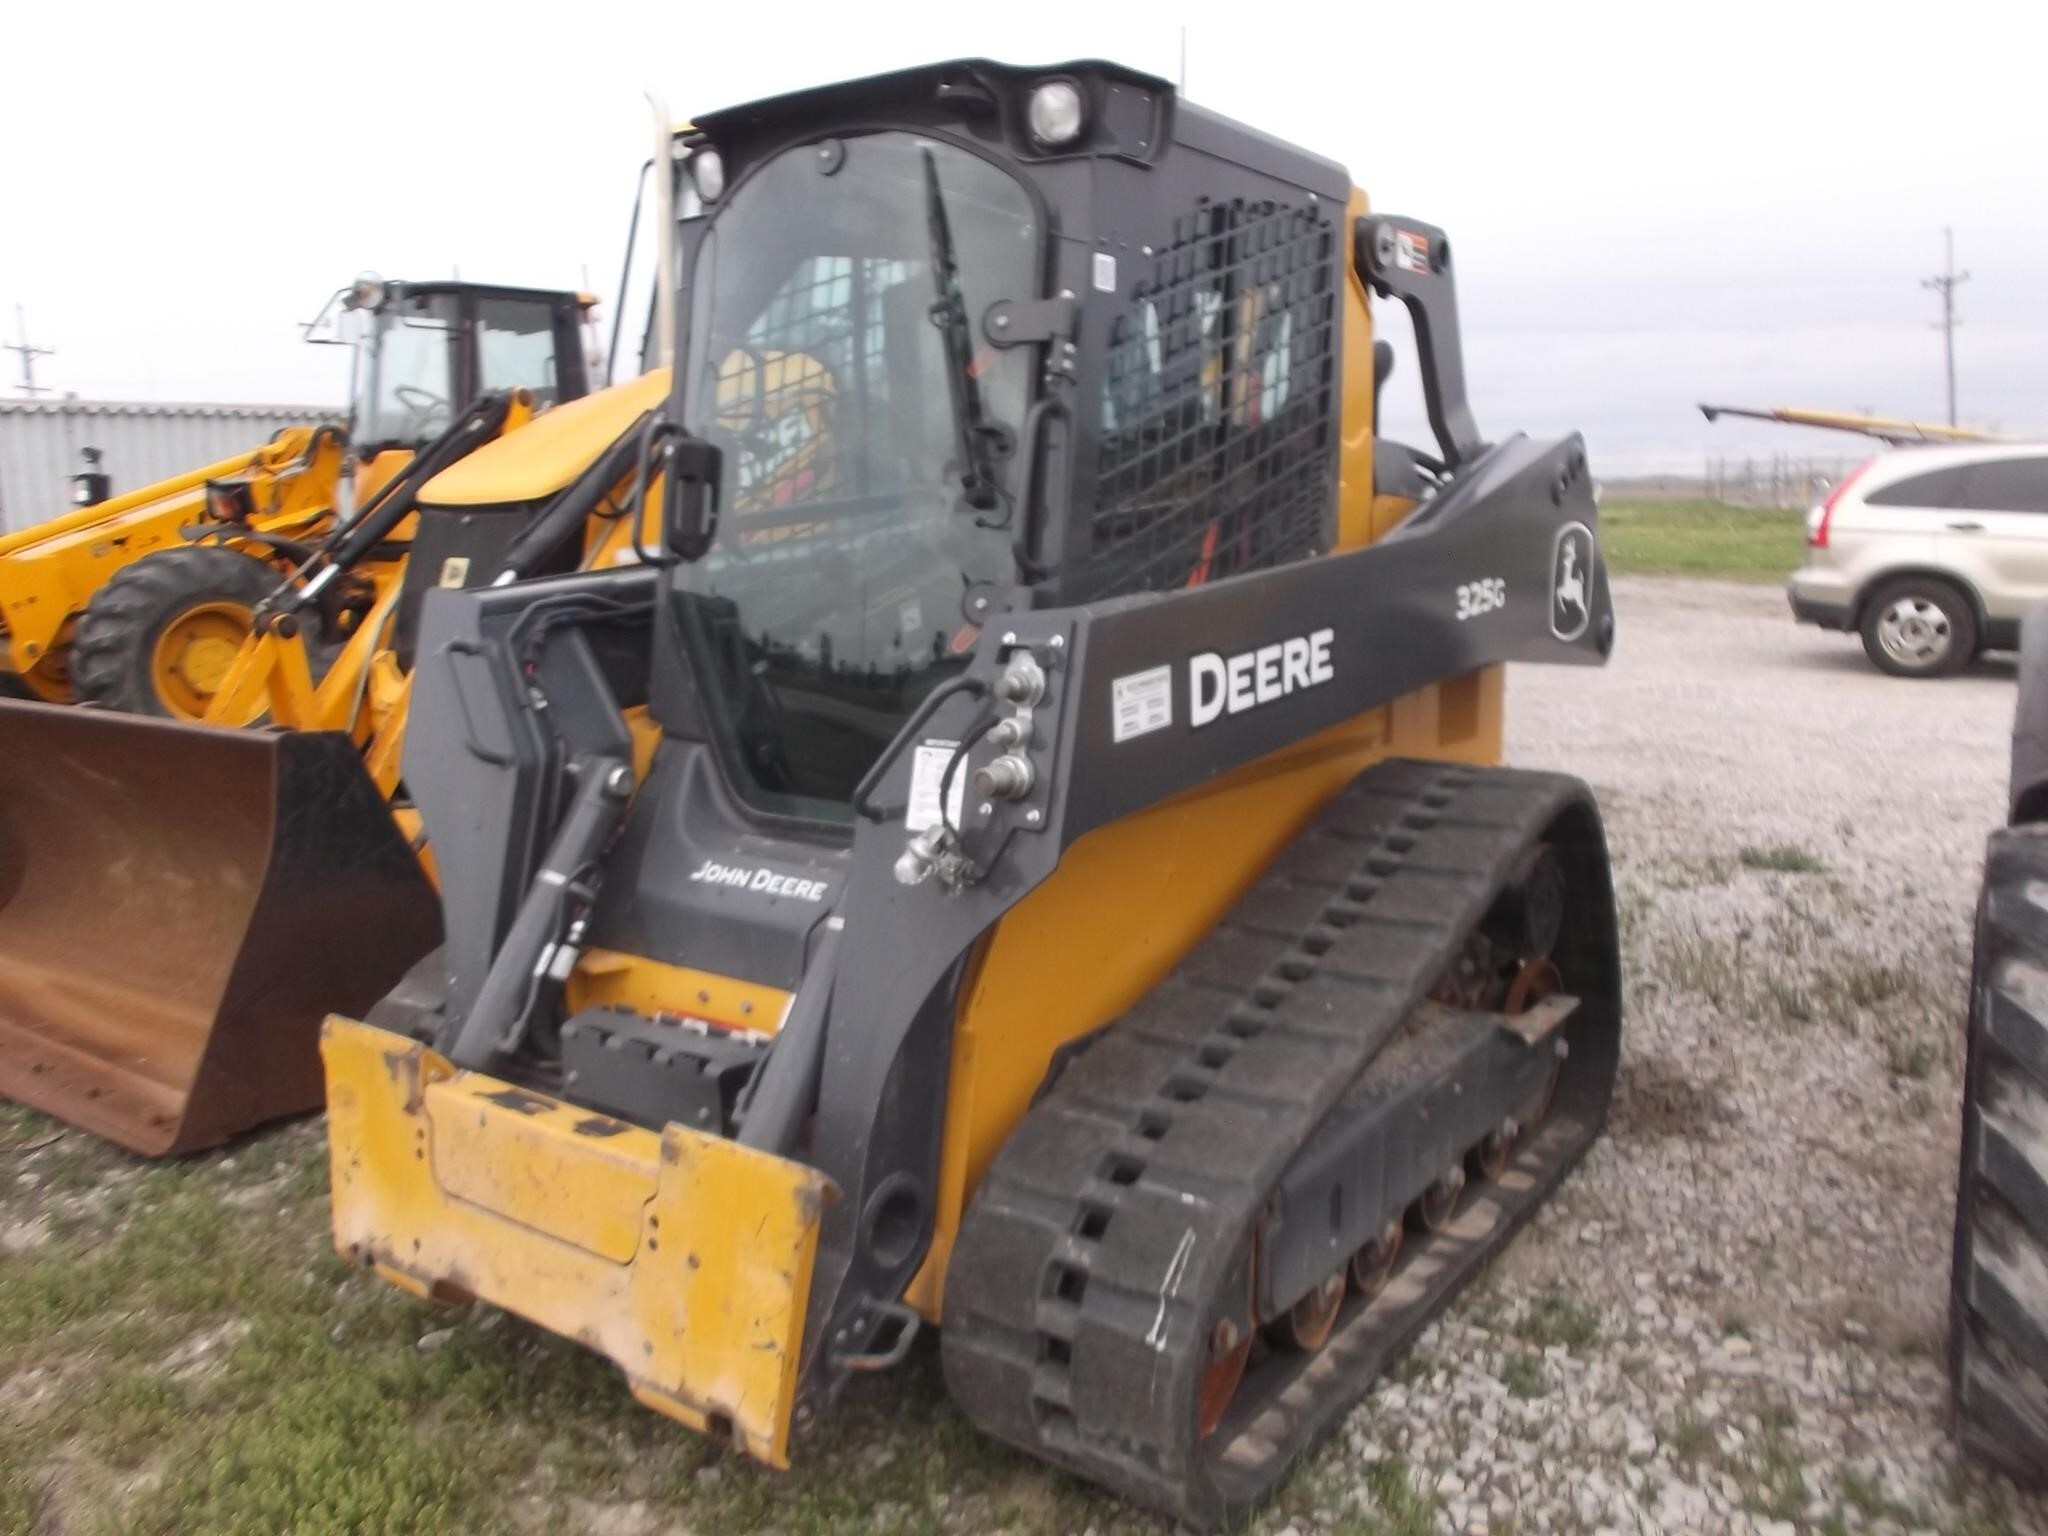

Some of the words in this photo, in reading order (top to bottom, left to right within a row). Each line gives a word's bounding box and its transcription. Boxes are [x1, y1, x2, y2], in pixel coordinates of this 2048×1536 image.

[1456, 577, 1506, 620] 325G
[1190, 628, 1334, 727] DEERE
[690, 860, 753, 888] JOHN
[749, 868, 828, 902] DEERE
